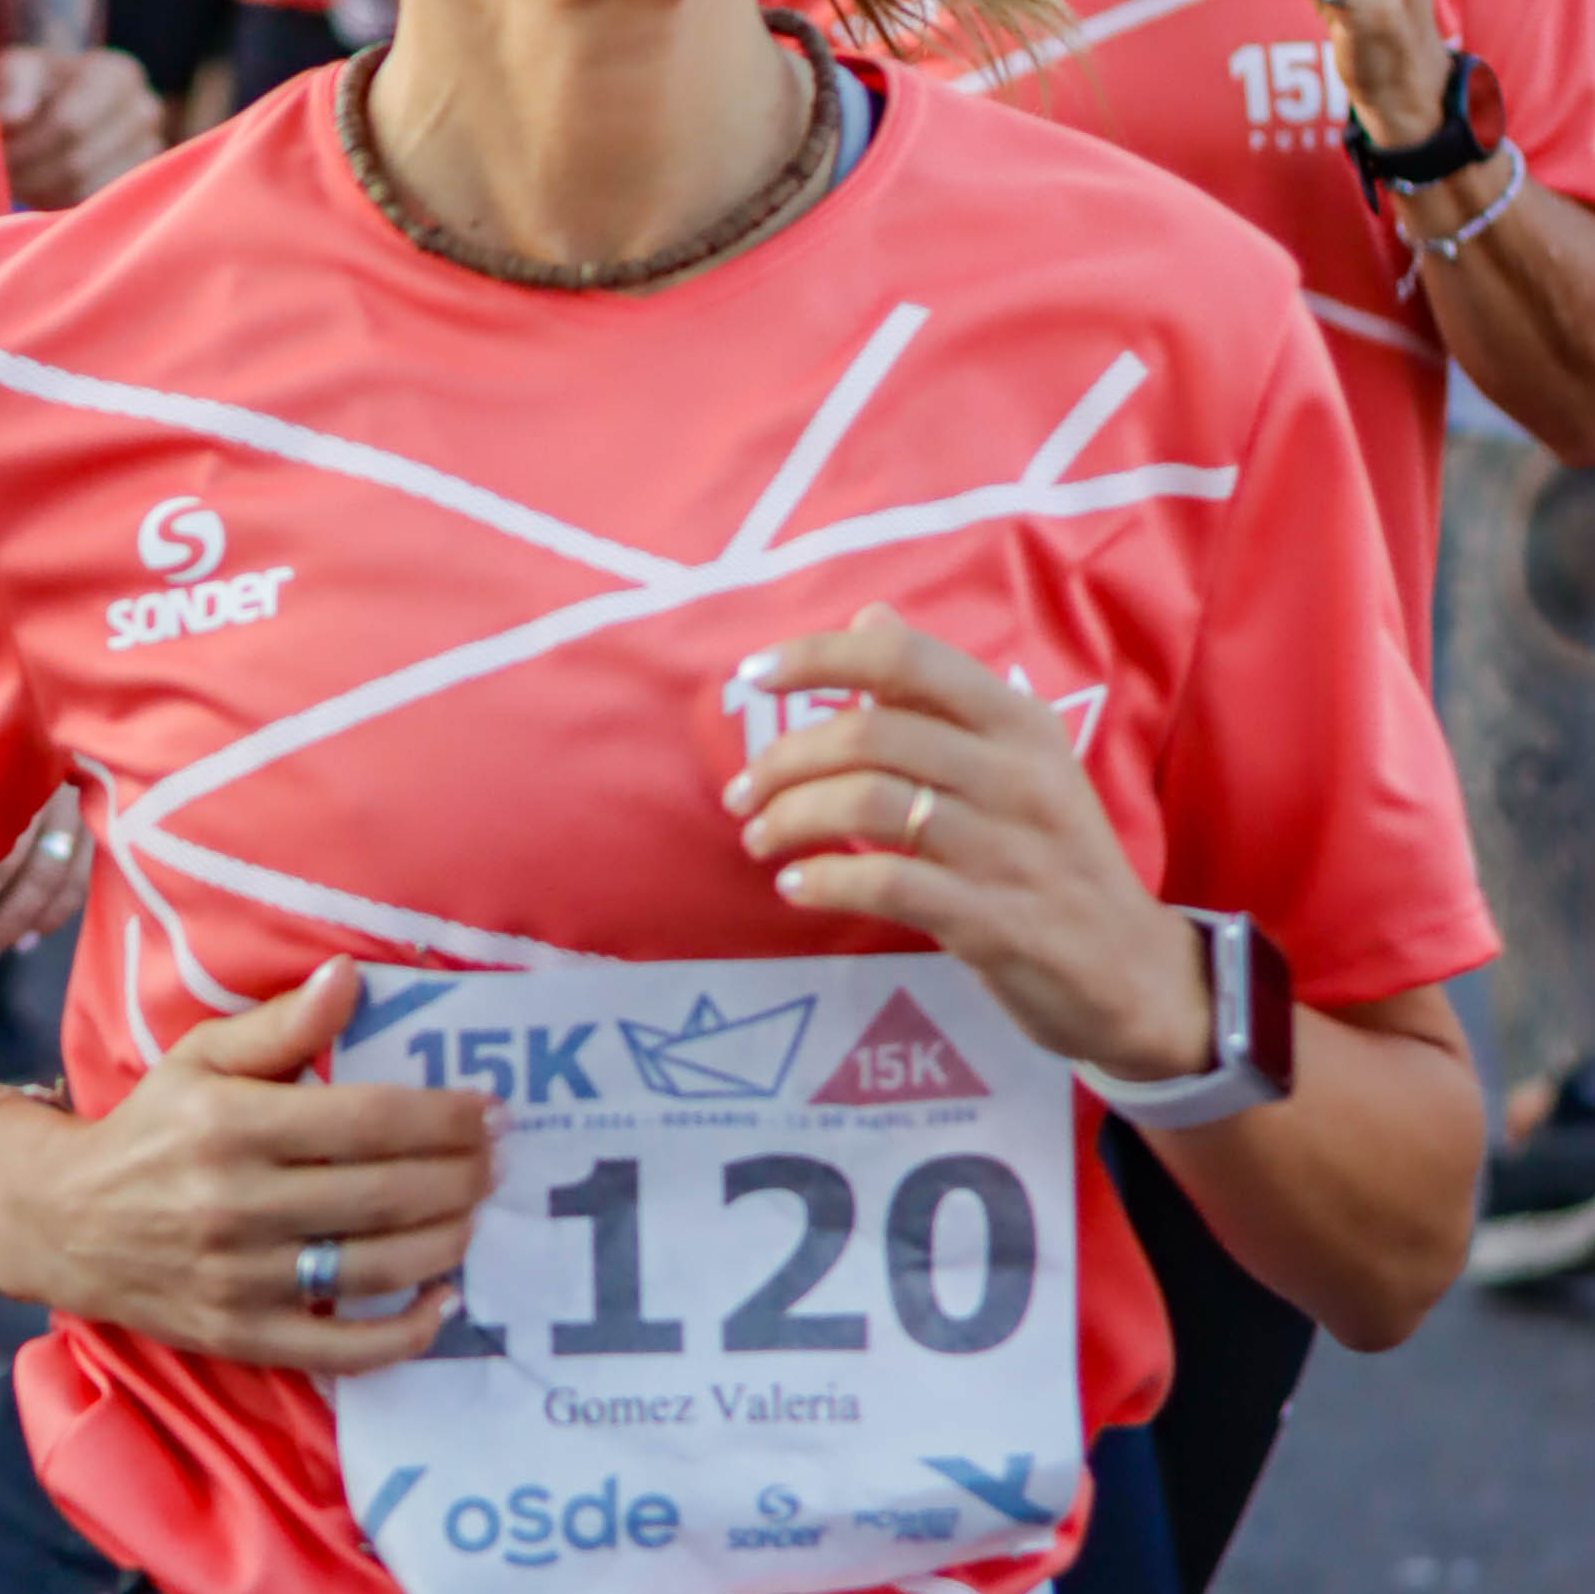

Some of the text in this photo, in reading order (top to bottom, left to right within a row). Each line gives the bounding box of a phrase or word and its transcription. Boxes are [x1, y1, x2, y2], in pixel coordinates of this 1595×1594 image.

[409, 1022, 600, 1104] 15K
[856, 1042, 948, 1089] 15K
[544, 1382, 862, 1426] Gomez Valeria
